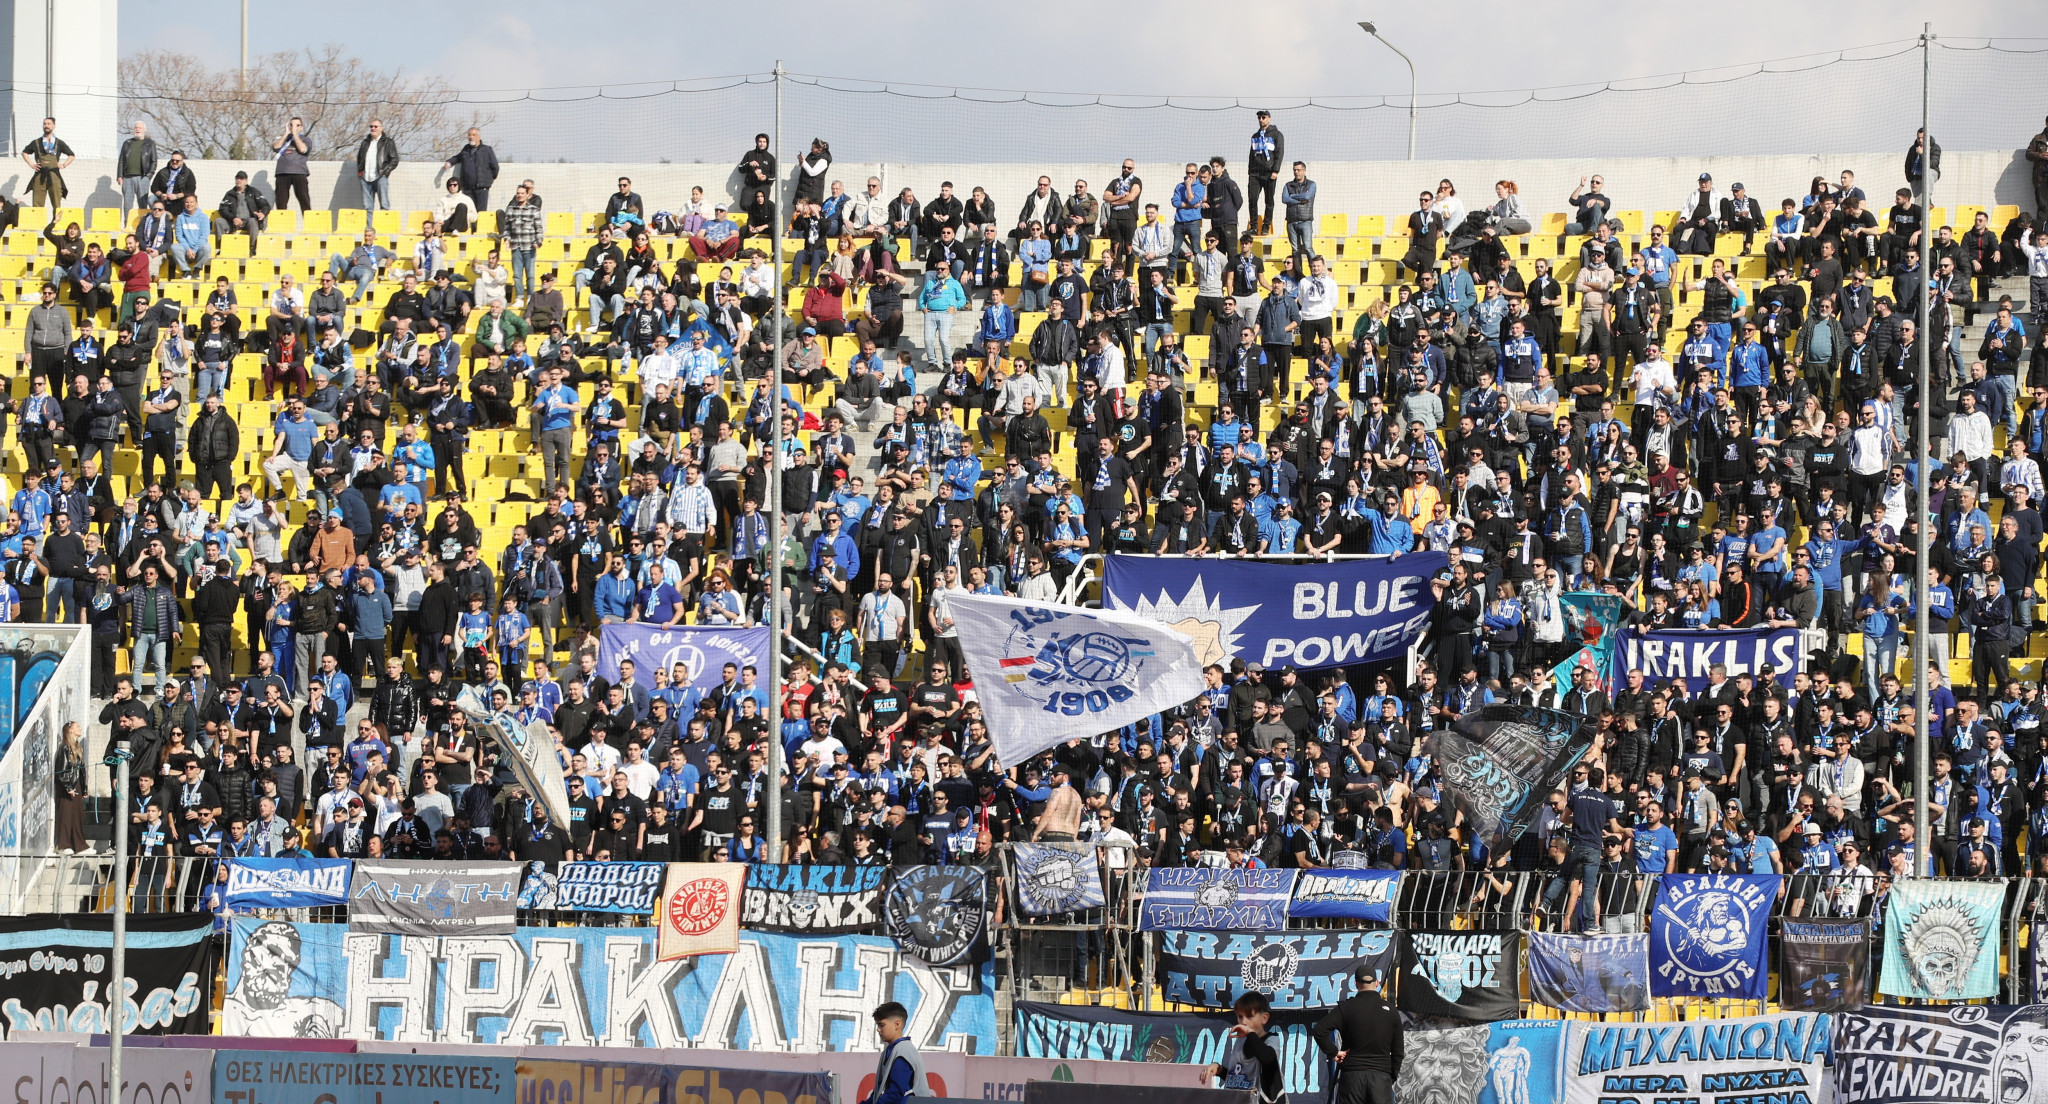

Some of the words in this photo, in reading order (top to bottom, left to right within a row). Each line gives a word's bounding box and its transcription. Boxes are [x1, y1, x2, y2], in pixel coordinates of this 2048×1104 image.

[1293, 576, 1422, 620] BLUE
[650, 633, 673, 646] ΘΑ
[1263, 610, 1430, 667] POWER
[1627, 635, 1796, 677] IRAKLIS
[1043, 684, 1134, 716] 1908
[411, 868, 467, 876] ΗΡΑΚΛΗΣ
[560, 863, 661, 886] IRAKLIS
[746, 864, 887, 893] IRAKLIS
[1158, 867, 1284, 888] ΗΡΑΚΛΗΣ
[556, 884, 657, 909] NEAPOLI
[1668, 874, 1769, 911] ΗΡΑΚΛΗΣ
[391, 915, 426, 925] ΑΙΩΝΙΑ
[430, 916, 475, 926] ΛΑΤΡΕΙΑ
[1149, 903, 1276, 928] ΕΠΑΡΧΙΑ
[930, 938, 964, 962] WHITE
[957, 907, 981, 942] PRIDE
[1162, 929, 1395, 960] IRAKLIS
[29, 951, 78, 975] Θύρα
[83, 953, 105, 974] 10
[1657, 960, 1756, 995] ΔΡΥΜΟΣ
[343, 931, 972, 1053] ΗΡΑΚΛΗΣ
[1501, 1020, 1559, 1029] ΗΡΑΚΛΗΣ
[1835, 1012, 1996, 1065] IRAKLIS
[1579, 1015, 1834, 1075] ΜΗΧΑΝΙΩΝΑ
[226, 1061, 263, 1083] ΘΕΣ
[270, 1062, 386, 1086] ΗΛΕΚΤΡΙΚΕΣ
[392, 1064, 500, 1094] ΣΥΣΚΕΥΕΣ;
[1605, 1075, 1687, 1092] ΜΕΡΑ
[1703, 1069, 1808, 1091] ΝΥΧΤΑ
